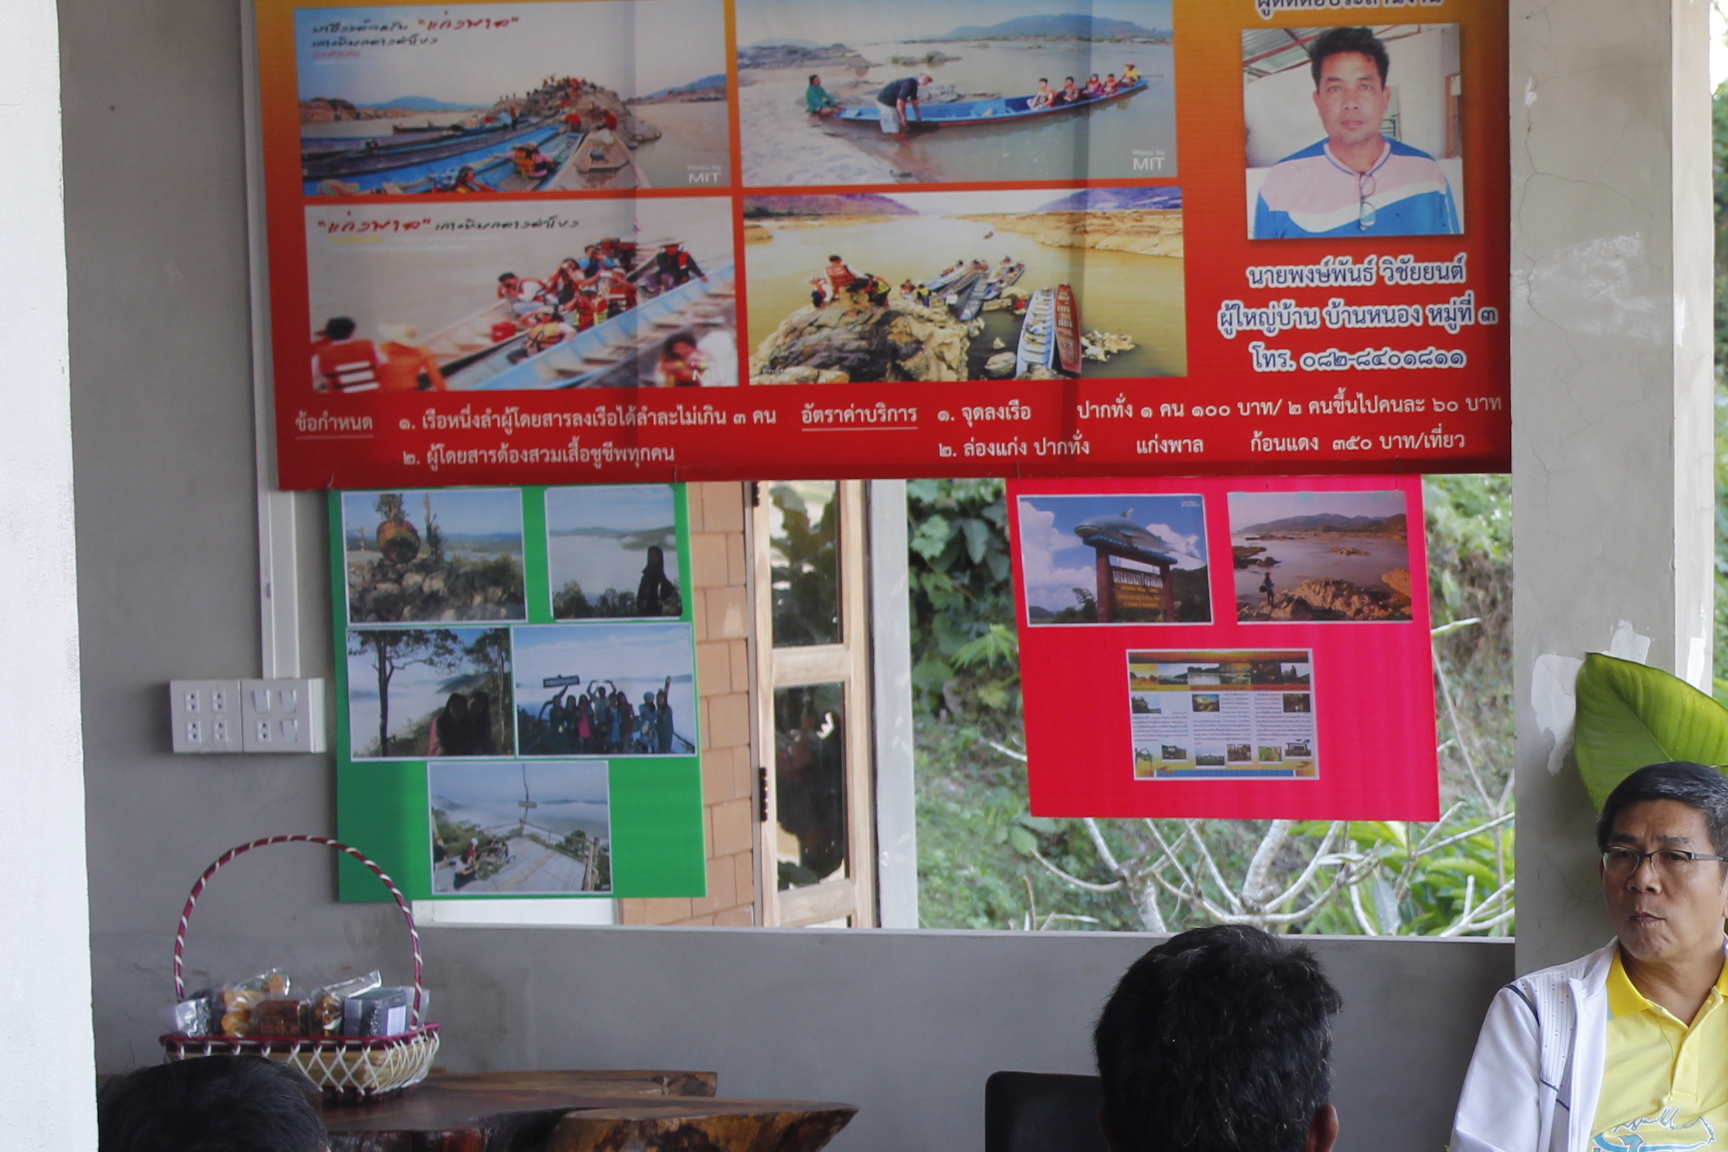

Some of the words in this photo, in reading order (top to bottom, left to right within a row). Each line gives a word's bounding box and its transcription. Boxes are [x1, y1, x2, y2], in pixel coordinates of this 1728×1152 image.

[1133, 157, 1166, 170] MIT
[688, 172, 721, 183] MIT
[1247, 255, 1375, 286] นายพงษ์พันธ์
[1381, 253, 1466, 283] วิชัยยนต์
[1219, 302, 1318, 336] ผู้ใหญ่บ้าน
[1325, 302, 1420, 326] บ้านหนอง
[1428, 293, 1473, 331] หมู่ที่
[1480, 309, 1497, 323] ๓
[1251, 344, 1295, 369] โทร.
[1302, 348, 1466, 369] ๐๘๒-๘๔๐๑๘๑๑
[801, 402, 917, 424] อัตราค่าบริการ
[937, 409, 955, 422] ๑.
[961, 399, 1031, 427] จุดลงเรือ
[1077, 393, 1133, 419] ปากทั่ง
[1140, 405, 1153, 418] ๑
[1160, 402, 1185, 418] คน
[1191, 404, 1230, 417] ๑๐๐
[1237, 399, 1283, 416] บาท/
[1288, 400, 1302, 415] ๒
[1308, 387, 1426, 415] คนขึ้นไปคนละ
[1465, 396, 1501, 412] บาท
[295, 410, 374, 432] ข้อกำหนด
[399, 418, 416, 430] ๑.
[733, 412, 746, 425] ๓
[753, 408, 776, 424] คน
[938, 442, 957, 457] ๒.
[963, 436, 1028, 457] ล่องแก่ง
[1033, 429, 1090, 456] ปากทั่ง
[1136, 434, 1204, 454] แก่งพาล
[1250, 430, 1319, 452] ก้อนแดง
[1379, 423, 1466, 450] บาท/เที่ยว
[402, 450, 420, 465] ๒.
[427, 436, 675, 471] ผู้โดยสารต้องสวมเสื้อชูชีพทุกคน
